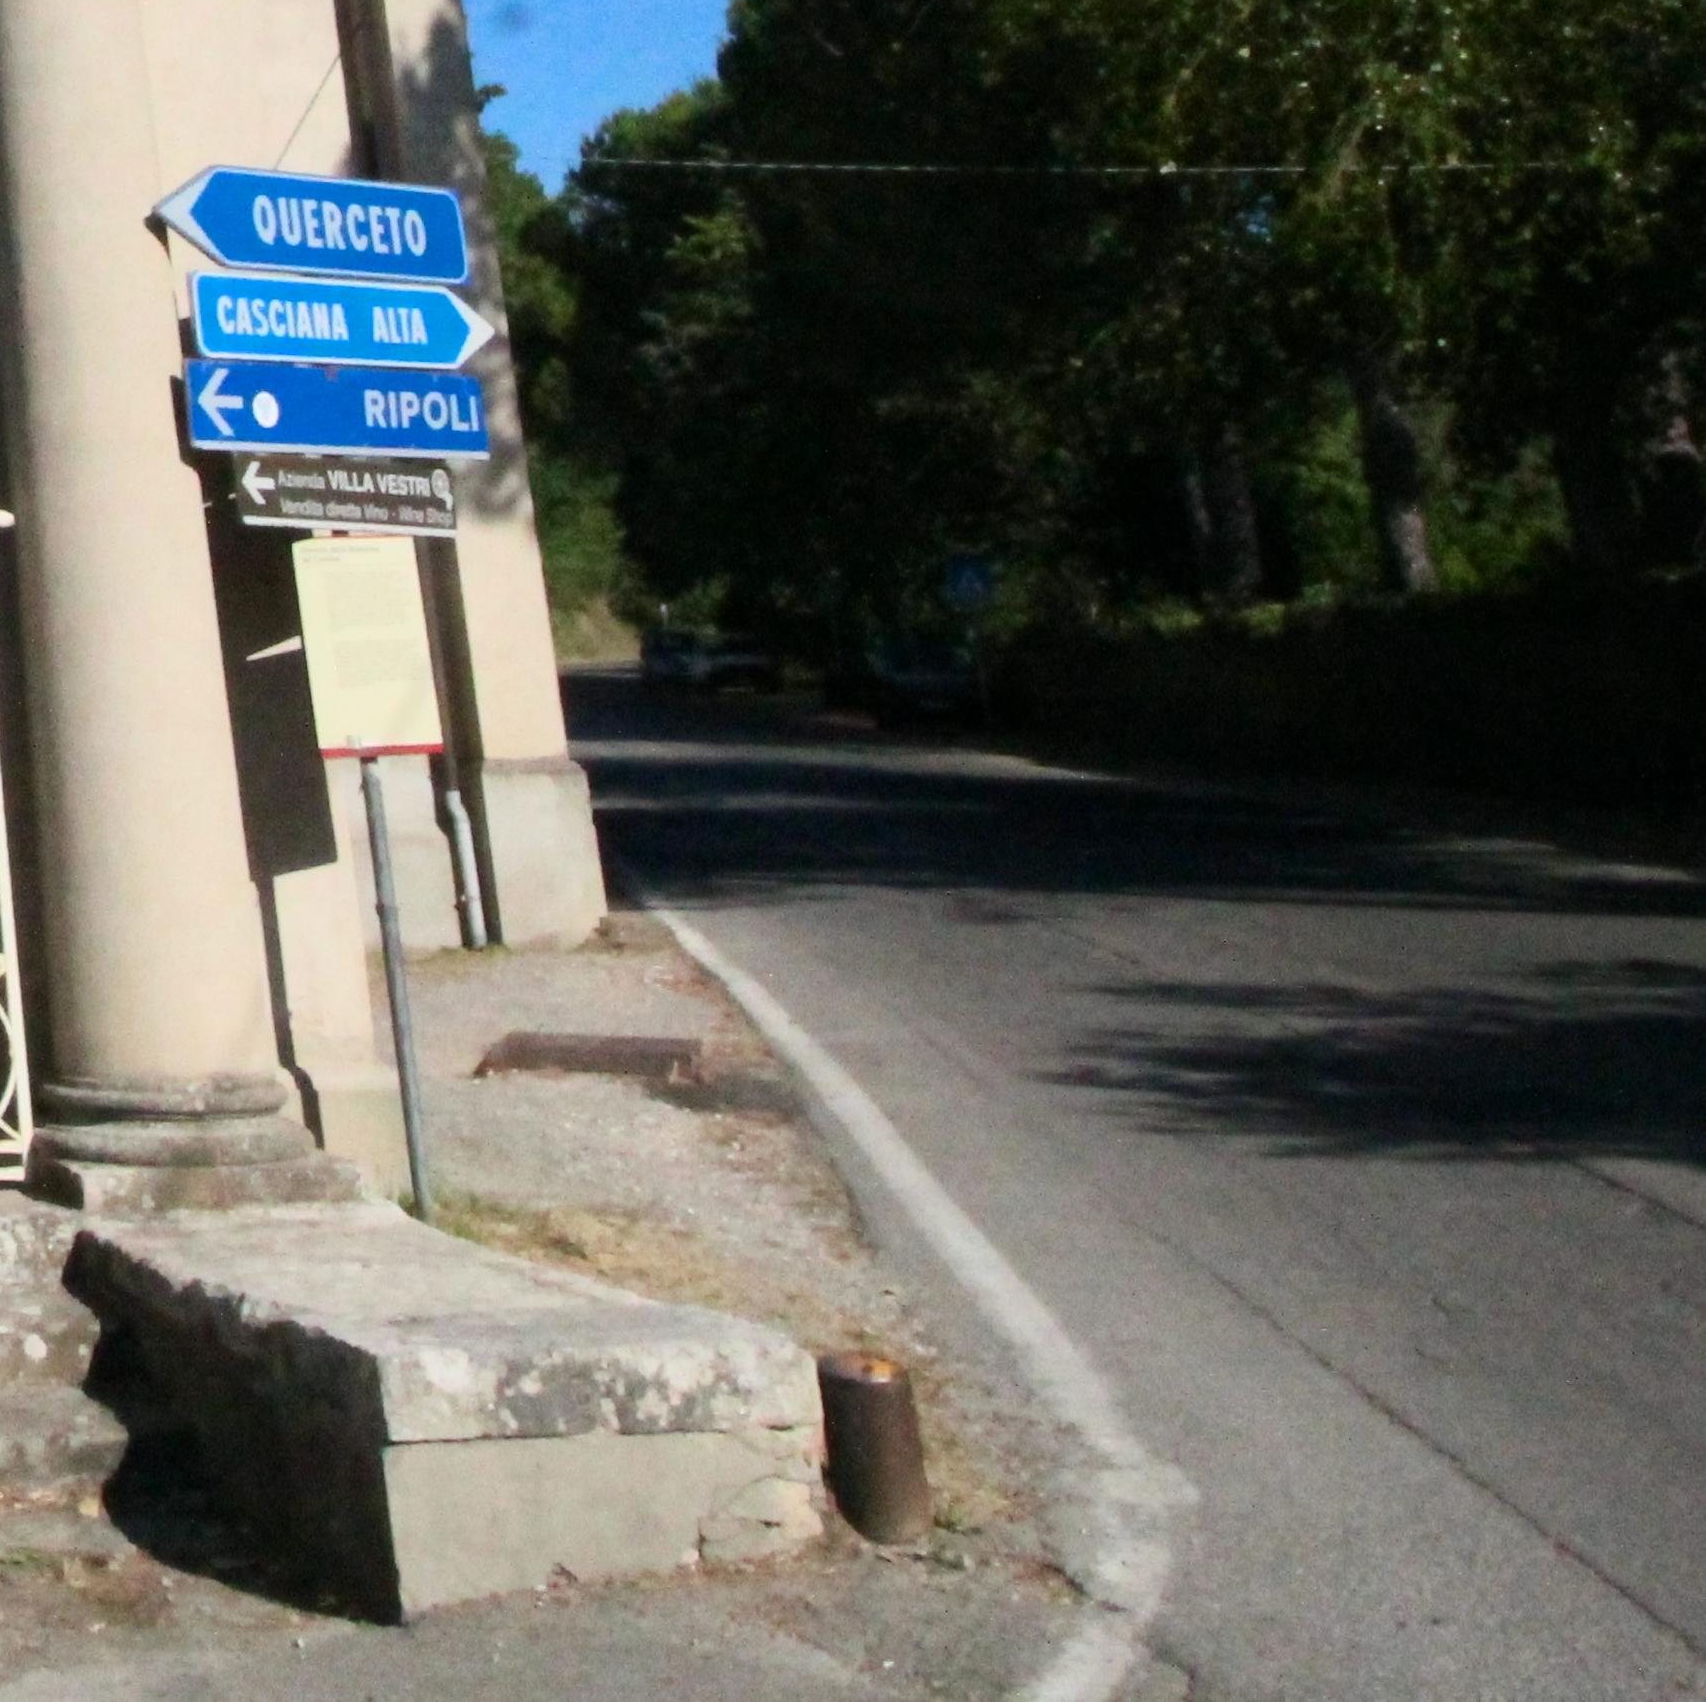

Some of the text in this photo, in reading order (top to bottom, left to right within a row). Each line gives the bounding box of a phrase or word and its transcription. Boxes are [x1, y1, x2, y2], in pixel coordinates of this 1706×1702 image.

[253, 195, 427, 256] QUERCETO
[217, 296, 428, 345] CASCIANA ALTA
[363, 389, 480, 431] RIPOLI
[327, 470, 375, 493] VILLA
[376, 473, 431, 498] VESTRI
